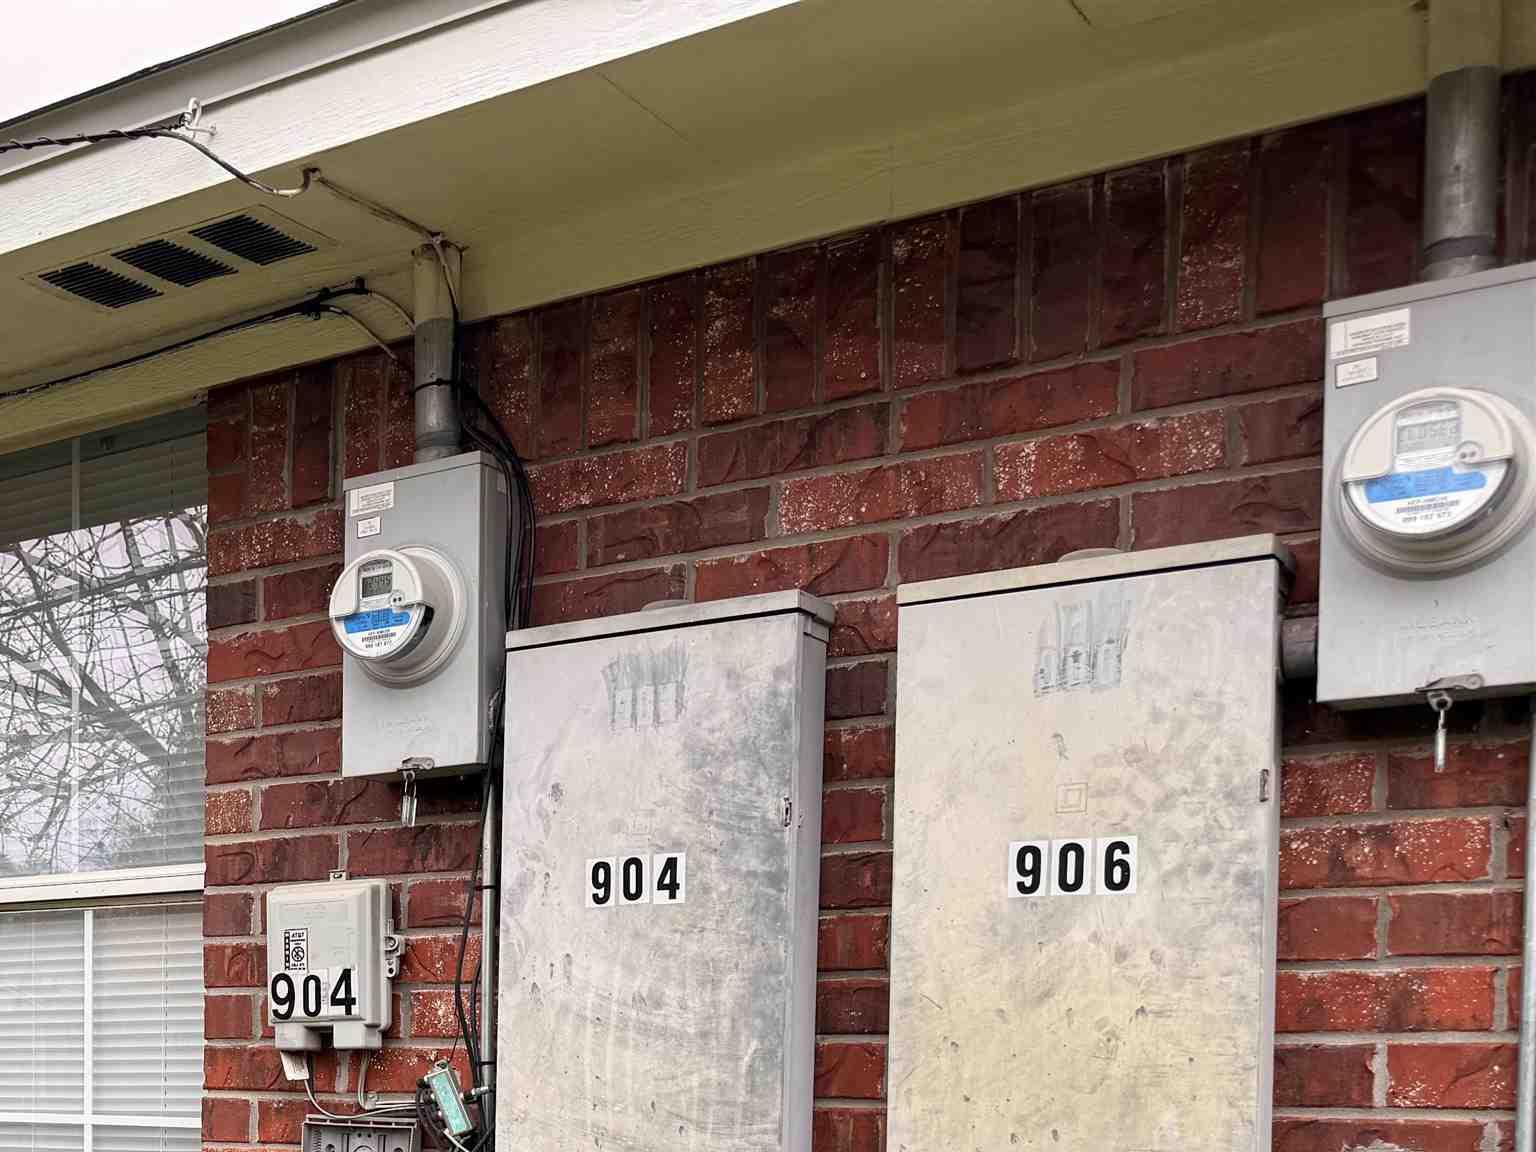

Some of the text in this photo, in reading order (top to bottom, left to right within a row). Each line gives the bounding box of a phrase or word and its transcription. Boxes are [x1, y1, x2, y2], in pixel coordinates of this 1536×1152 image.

[591, 857, 680, 905] 904
[1016, 841, 1131, 895] 906
[271, 968, 357, 1020] 904
